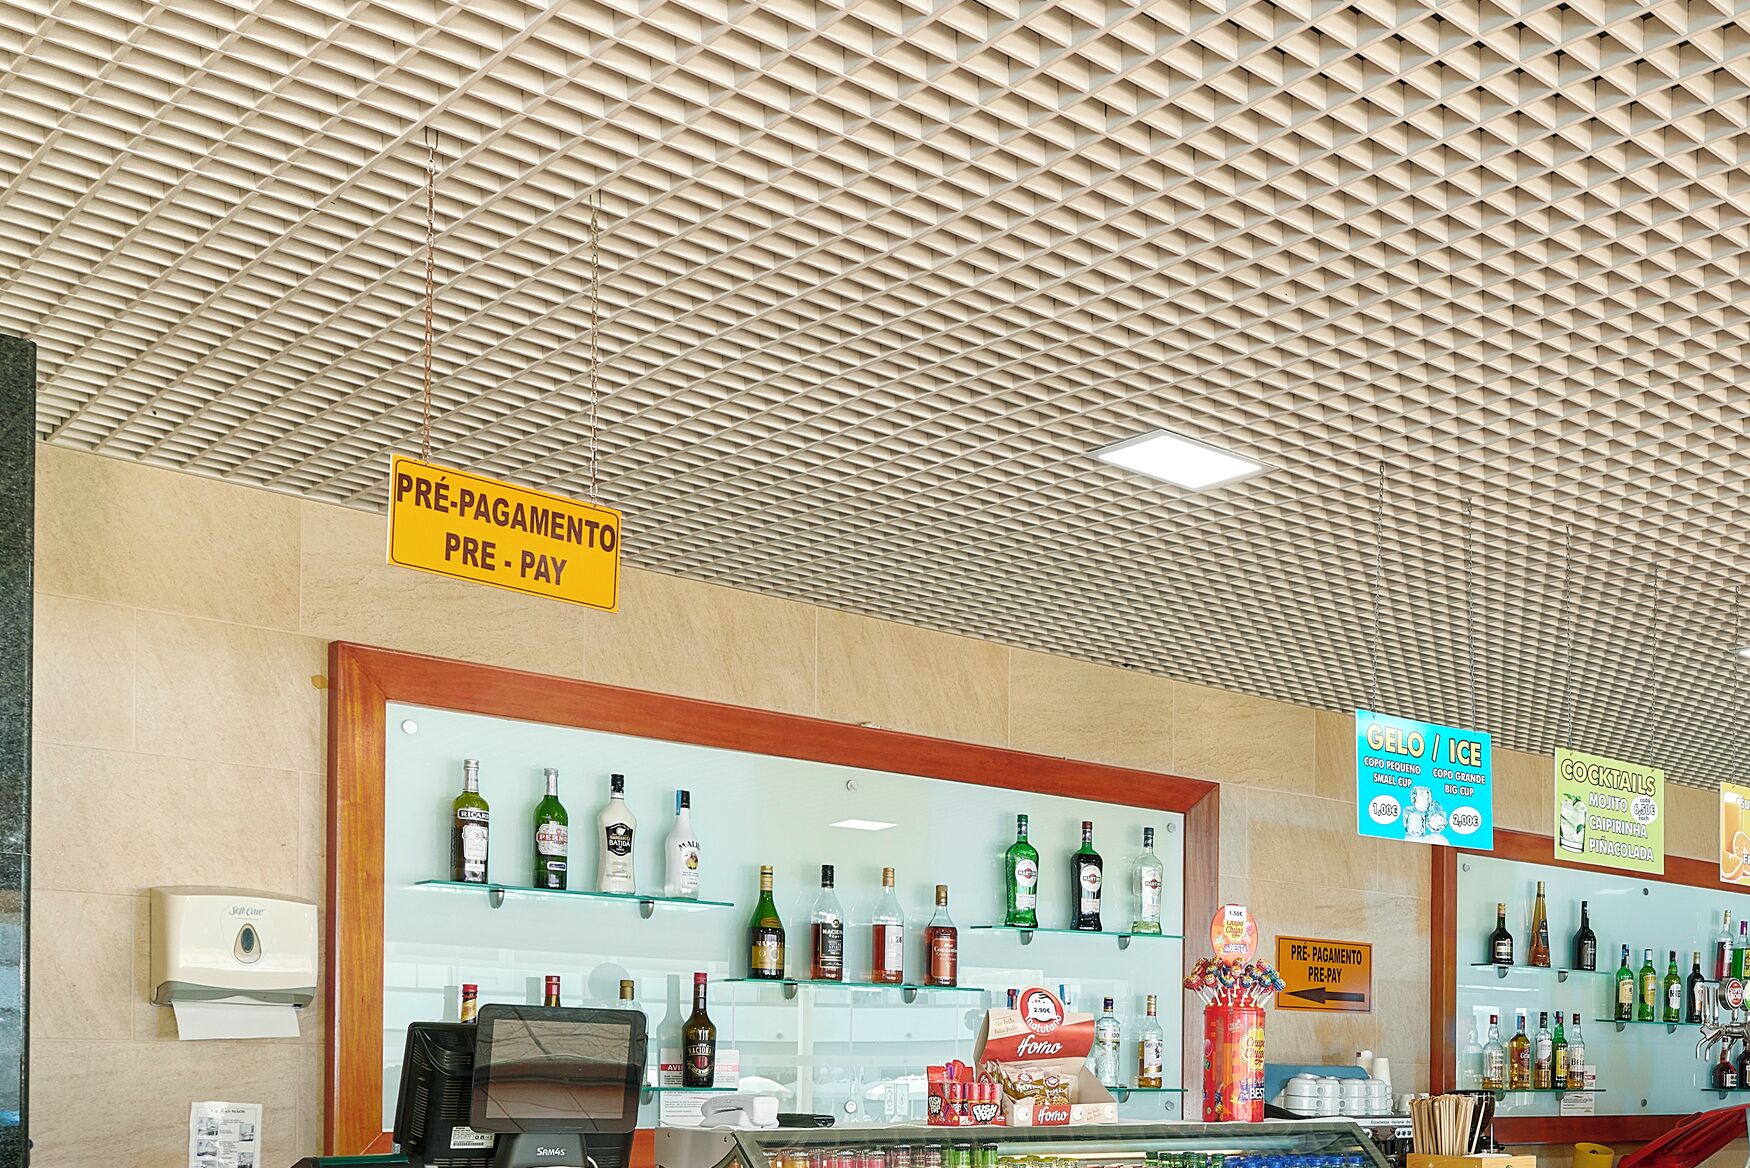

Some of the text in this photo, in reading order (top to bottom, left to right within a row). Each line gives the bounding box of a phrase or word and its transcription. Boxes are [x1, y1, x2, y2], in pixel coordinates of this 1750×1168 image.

[397, 472, 616, 553] PRÉ-PAGAMENTO
[445, 532, 496, 571] PRE
[520, 550, 567, 586] PAY
[1366, 722, 1482, 767] GELO / ICE
[1364, 756, 1421, 775] COPO PEQUENO
[1373, 773, 1412, 788] SMALL CUP
[1432, 767, 1486, 785] COPO GRANDE
[1560, 758, 1656, 796] COCKTAILS
[1444, 784, 1474, 797] BIG CUP
[1373, 802, 1398, 817] 1,00€
[1588, 792, 1628, 813] MOJITO
[1452, 814, 1478, 828] 2,00€
[1589, 815, 1648, 838] CAIPIRINHA
[1588, 836, 1654, 862] PIÑACOLADA
[228, 906, 265, 916] Soft Care
[1291, 942, 1362, 965] PRÉ- PAGAMENTO
[1308, 966, 1342, 983] PRE-PAY
[972, 1104, 998, 1115] PUSH
[976, 1111, 996, 1122] POP
